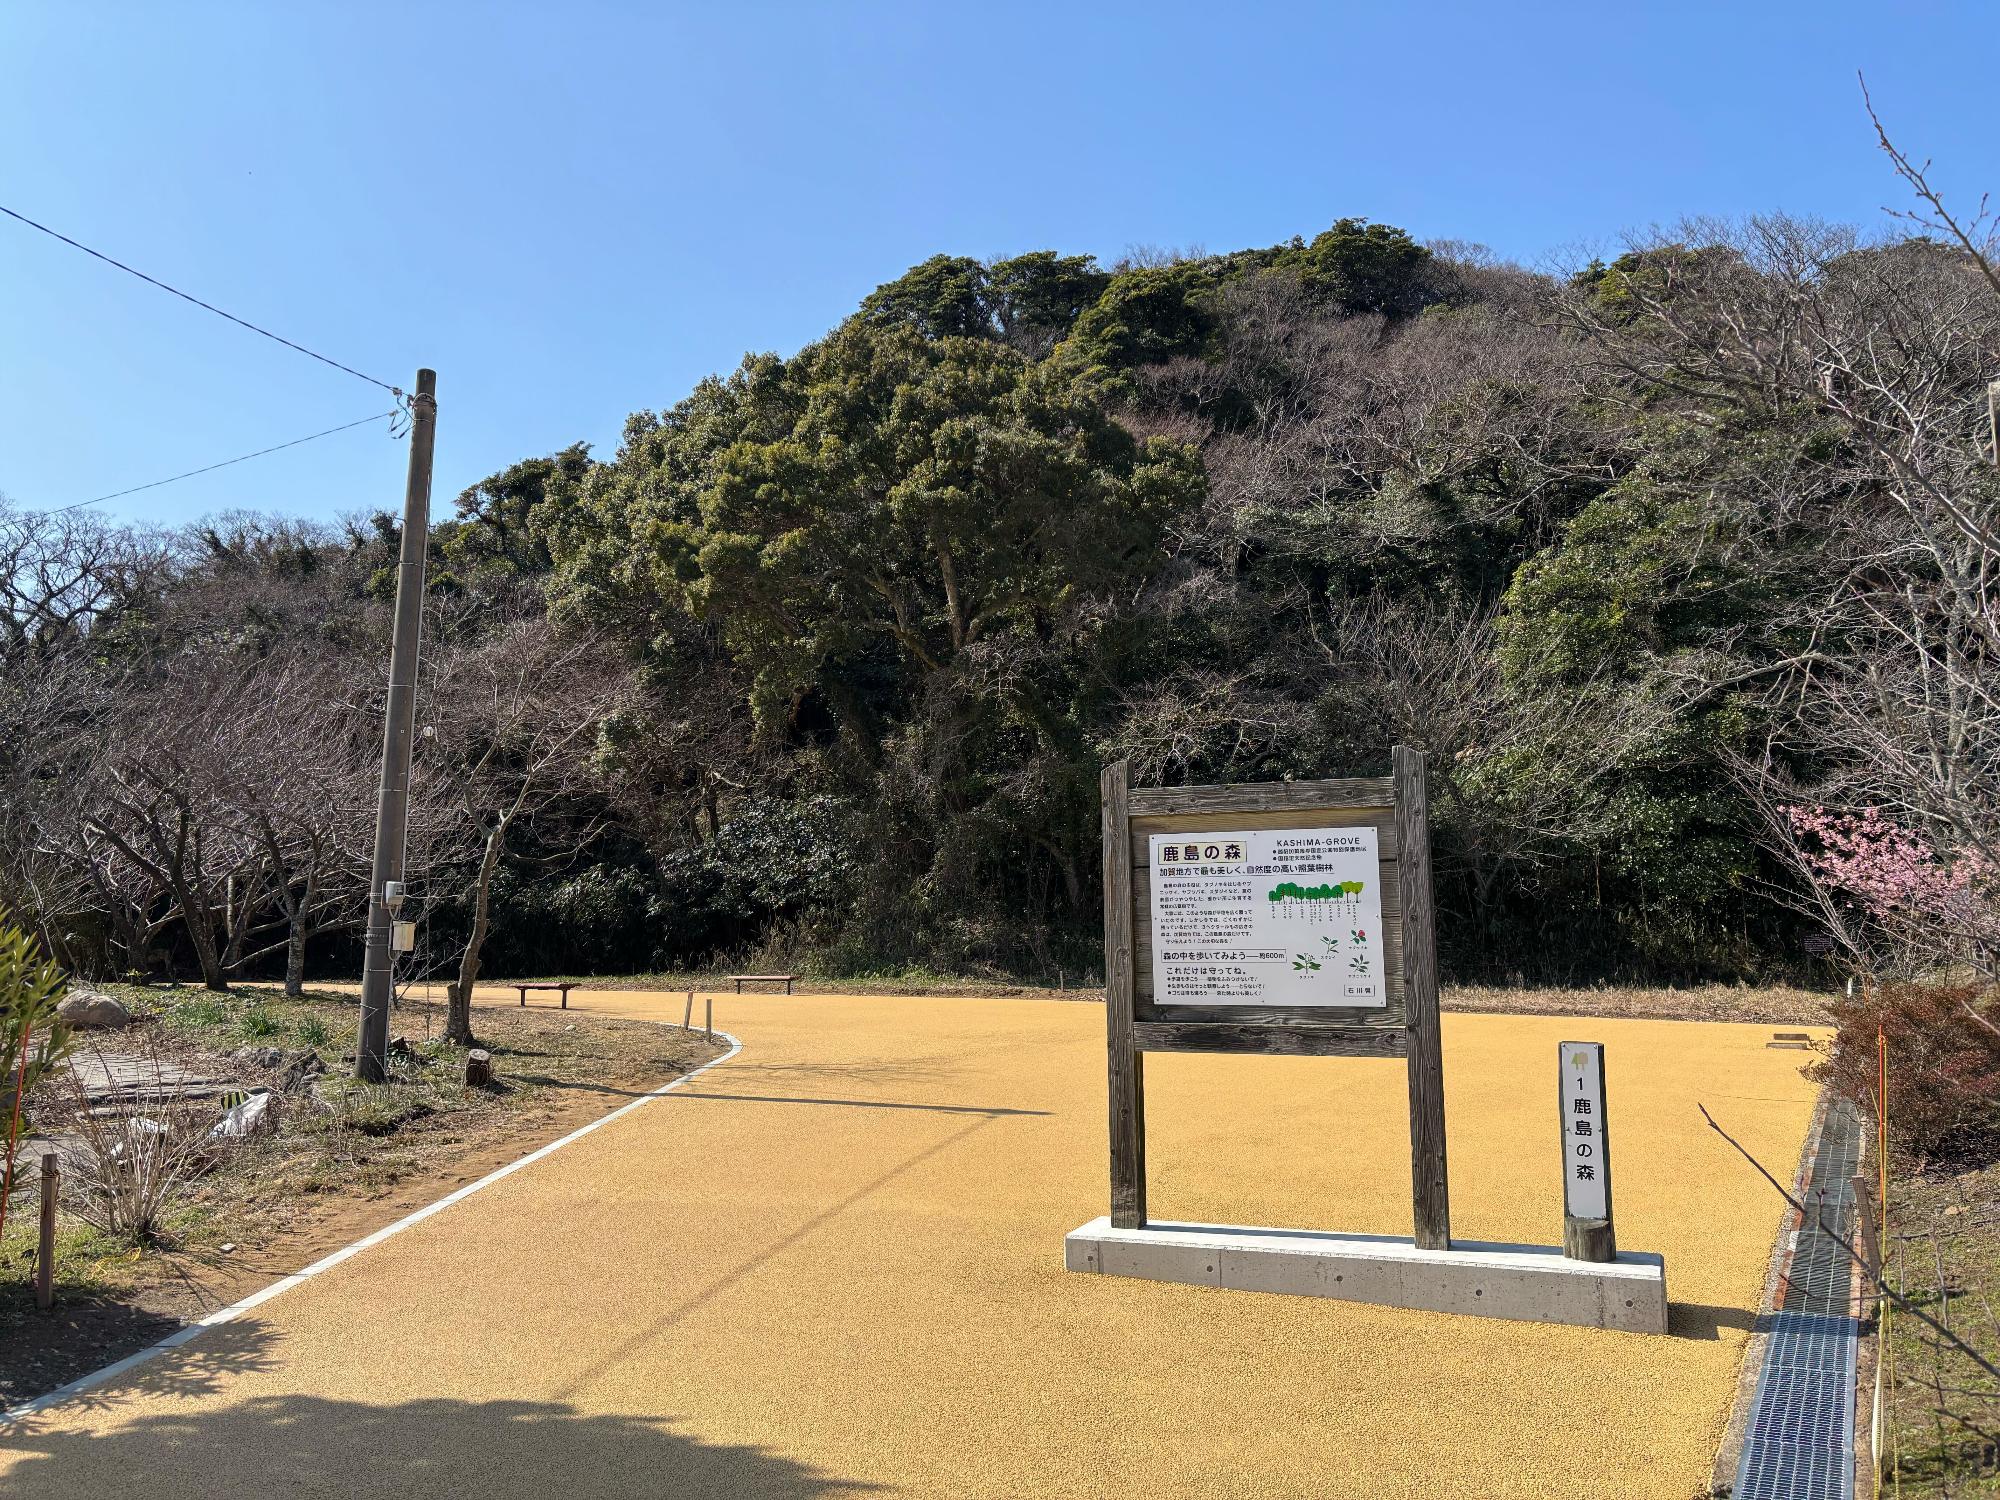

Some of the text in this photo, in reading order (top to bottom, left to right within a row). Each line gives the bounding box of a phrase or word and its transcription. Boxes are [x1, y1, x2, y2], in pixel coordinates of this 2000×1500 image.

[1276, 837, 1361, 847] KASHIMA-GROVE
[1163, 844, 1241, 862] 鹿島の森
[1160, 863, 1334, 877] 加賀地方で最も美しく、自然度の高い照葉樹林
[1166, 966, 1246, 975] これだけは守ってね。
